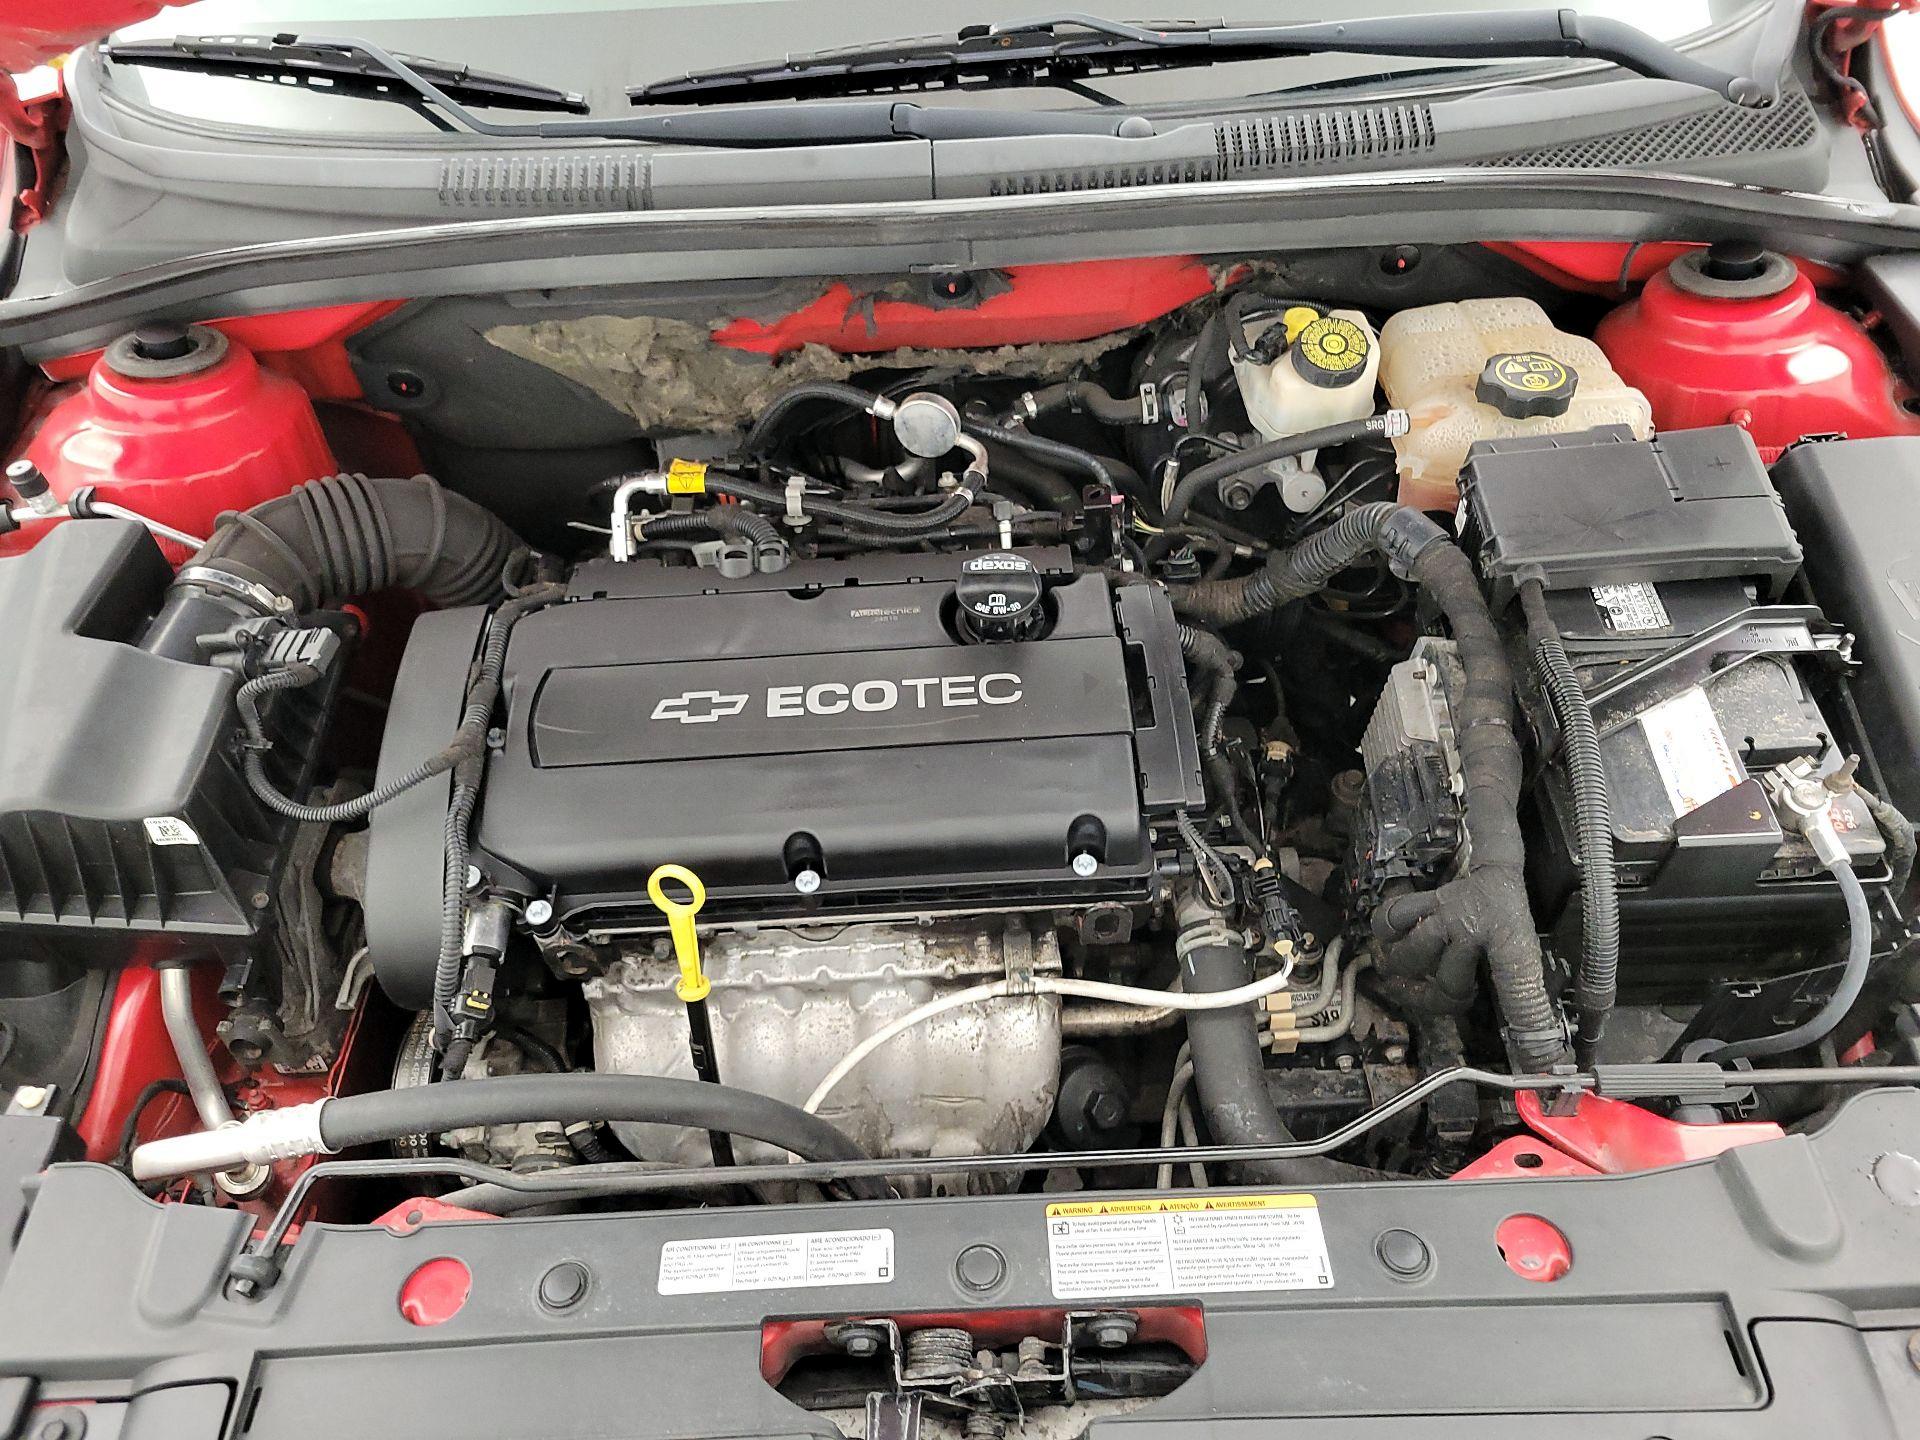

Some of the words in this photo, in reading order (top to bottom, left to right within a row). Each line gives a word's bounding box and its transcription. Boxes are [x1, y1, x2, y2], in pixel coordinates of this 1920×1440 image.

[969, 558, 1027, 571] dexos
[974, 602, 991, 614] SAE
[766, 672, 1023, 718] ECOTEC
[1215, 1200, 1266, 1208] AVERTISSEMENT
[1062, 1206, 1093, 1214] WARNING
[1110, 1205, 1152, 1213] ADVERTENCIA
[676, 1244, 717, 1253] CONDITIONING
